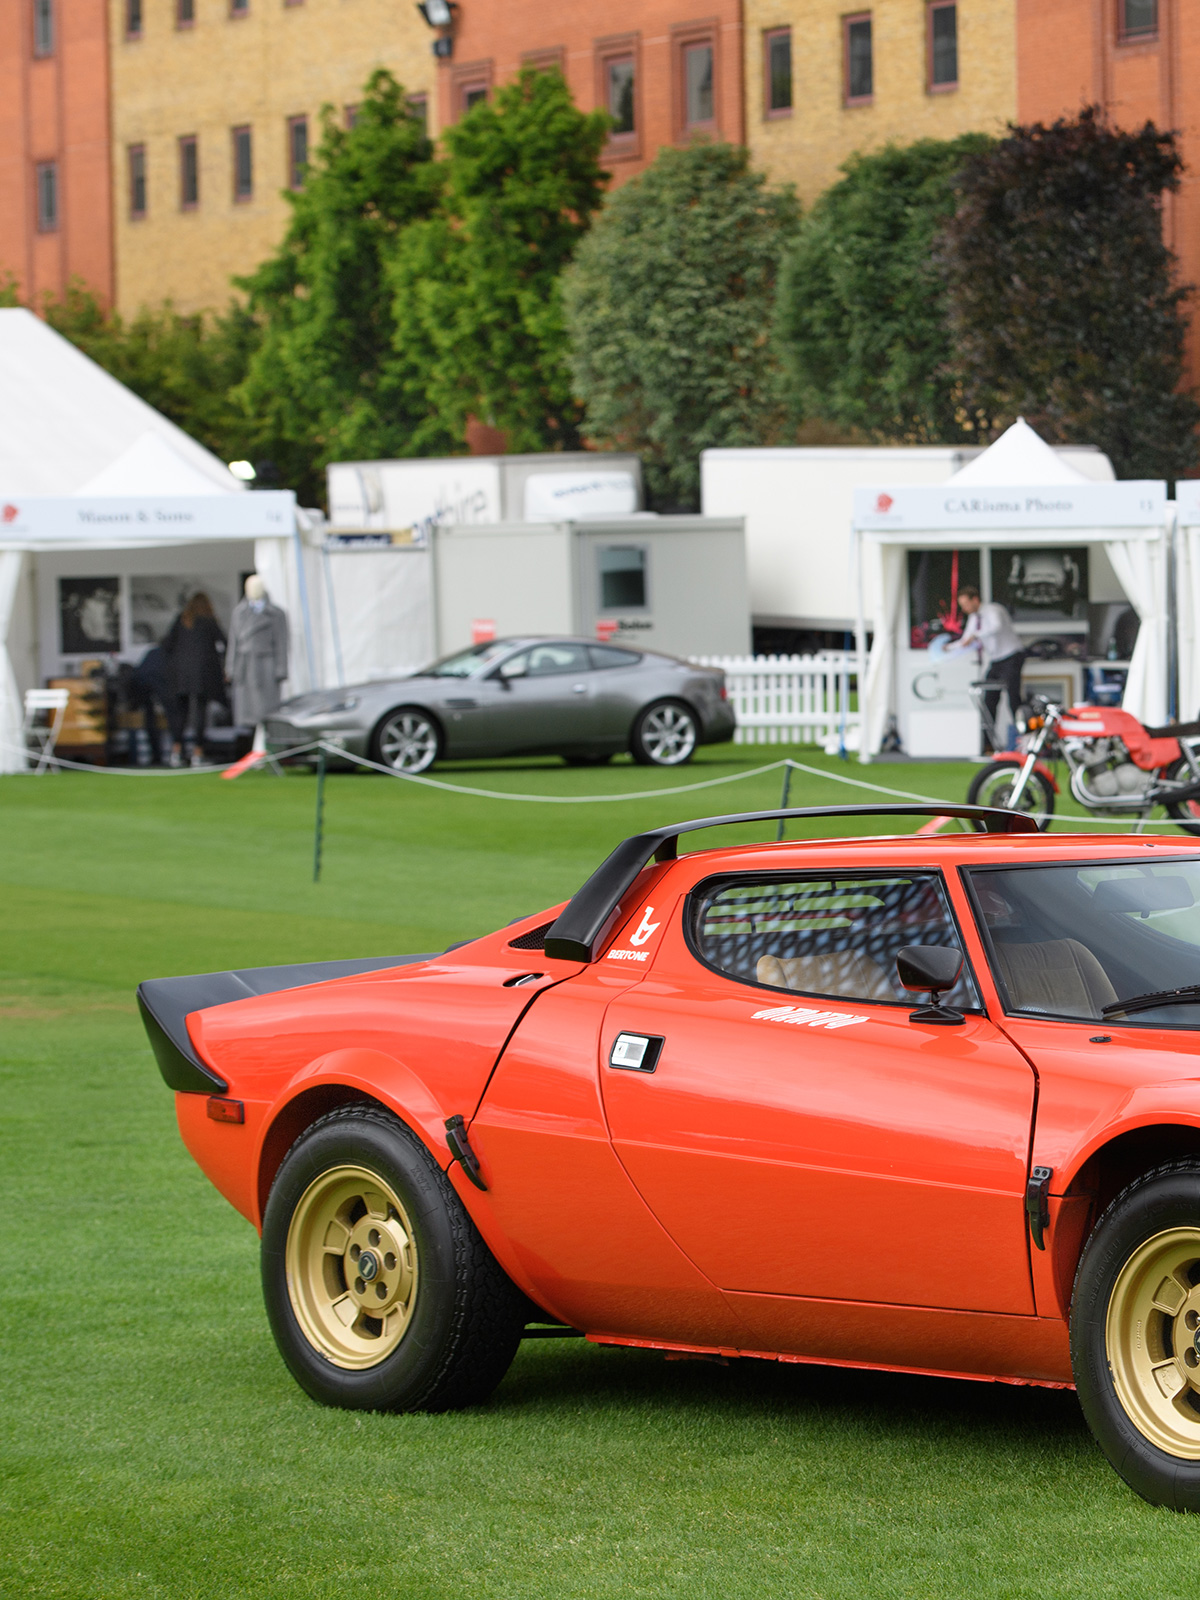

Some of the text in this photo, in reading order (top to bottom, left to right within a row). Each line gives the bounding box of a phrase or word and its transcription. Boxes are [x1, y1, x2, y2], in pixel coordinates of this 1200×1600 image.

[944, 497, 1073, 513] CARisma Photo
[607, 950, 650, 962] BERTONE
